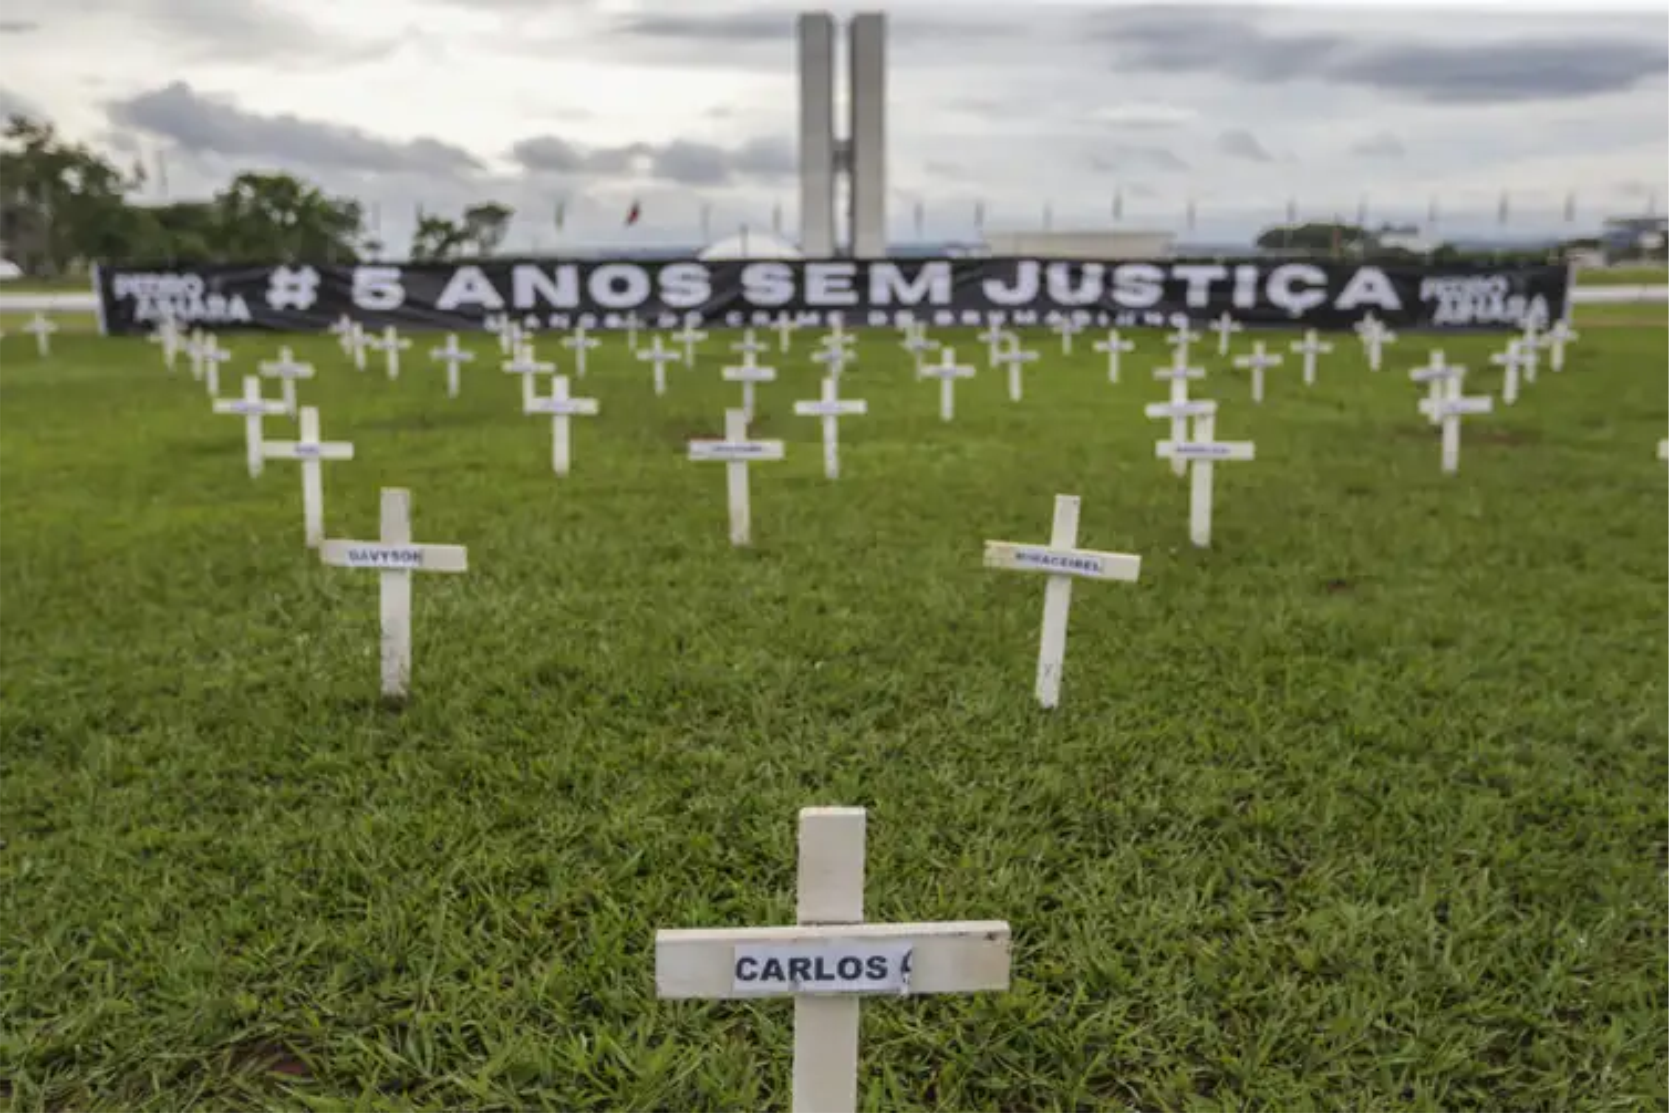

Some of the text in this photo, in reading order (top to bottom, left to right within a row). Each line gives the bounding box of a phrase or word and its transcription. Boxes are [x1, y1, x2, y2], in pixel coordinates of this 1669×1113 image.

[352, 266, 405, 310] 5
[436, 264, 711, 310] ANOS
[742, 262, 952, 307] SEM
[983, 261, 1400, 319] JUSTIÇA
[736, 955, 888, 982] CARLOS
